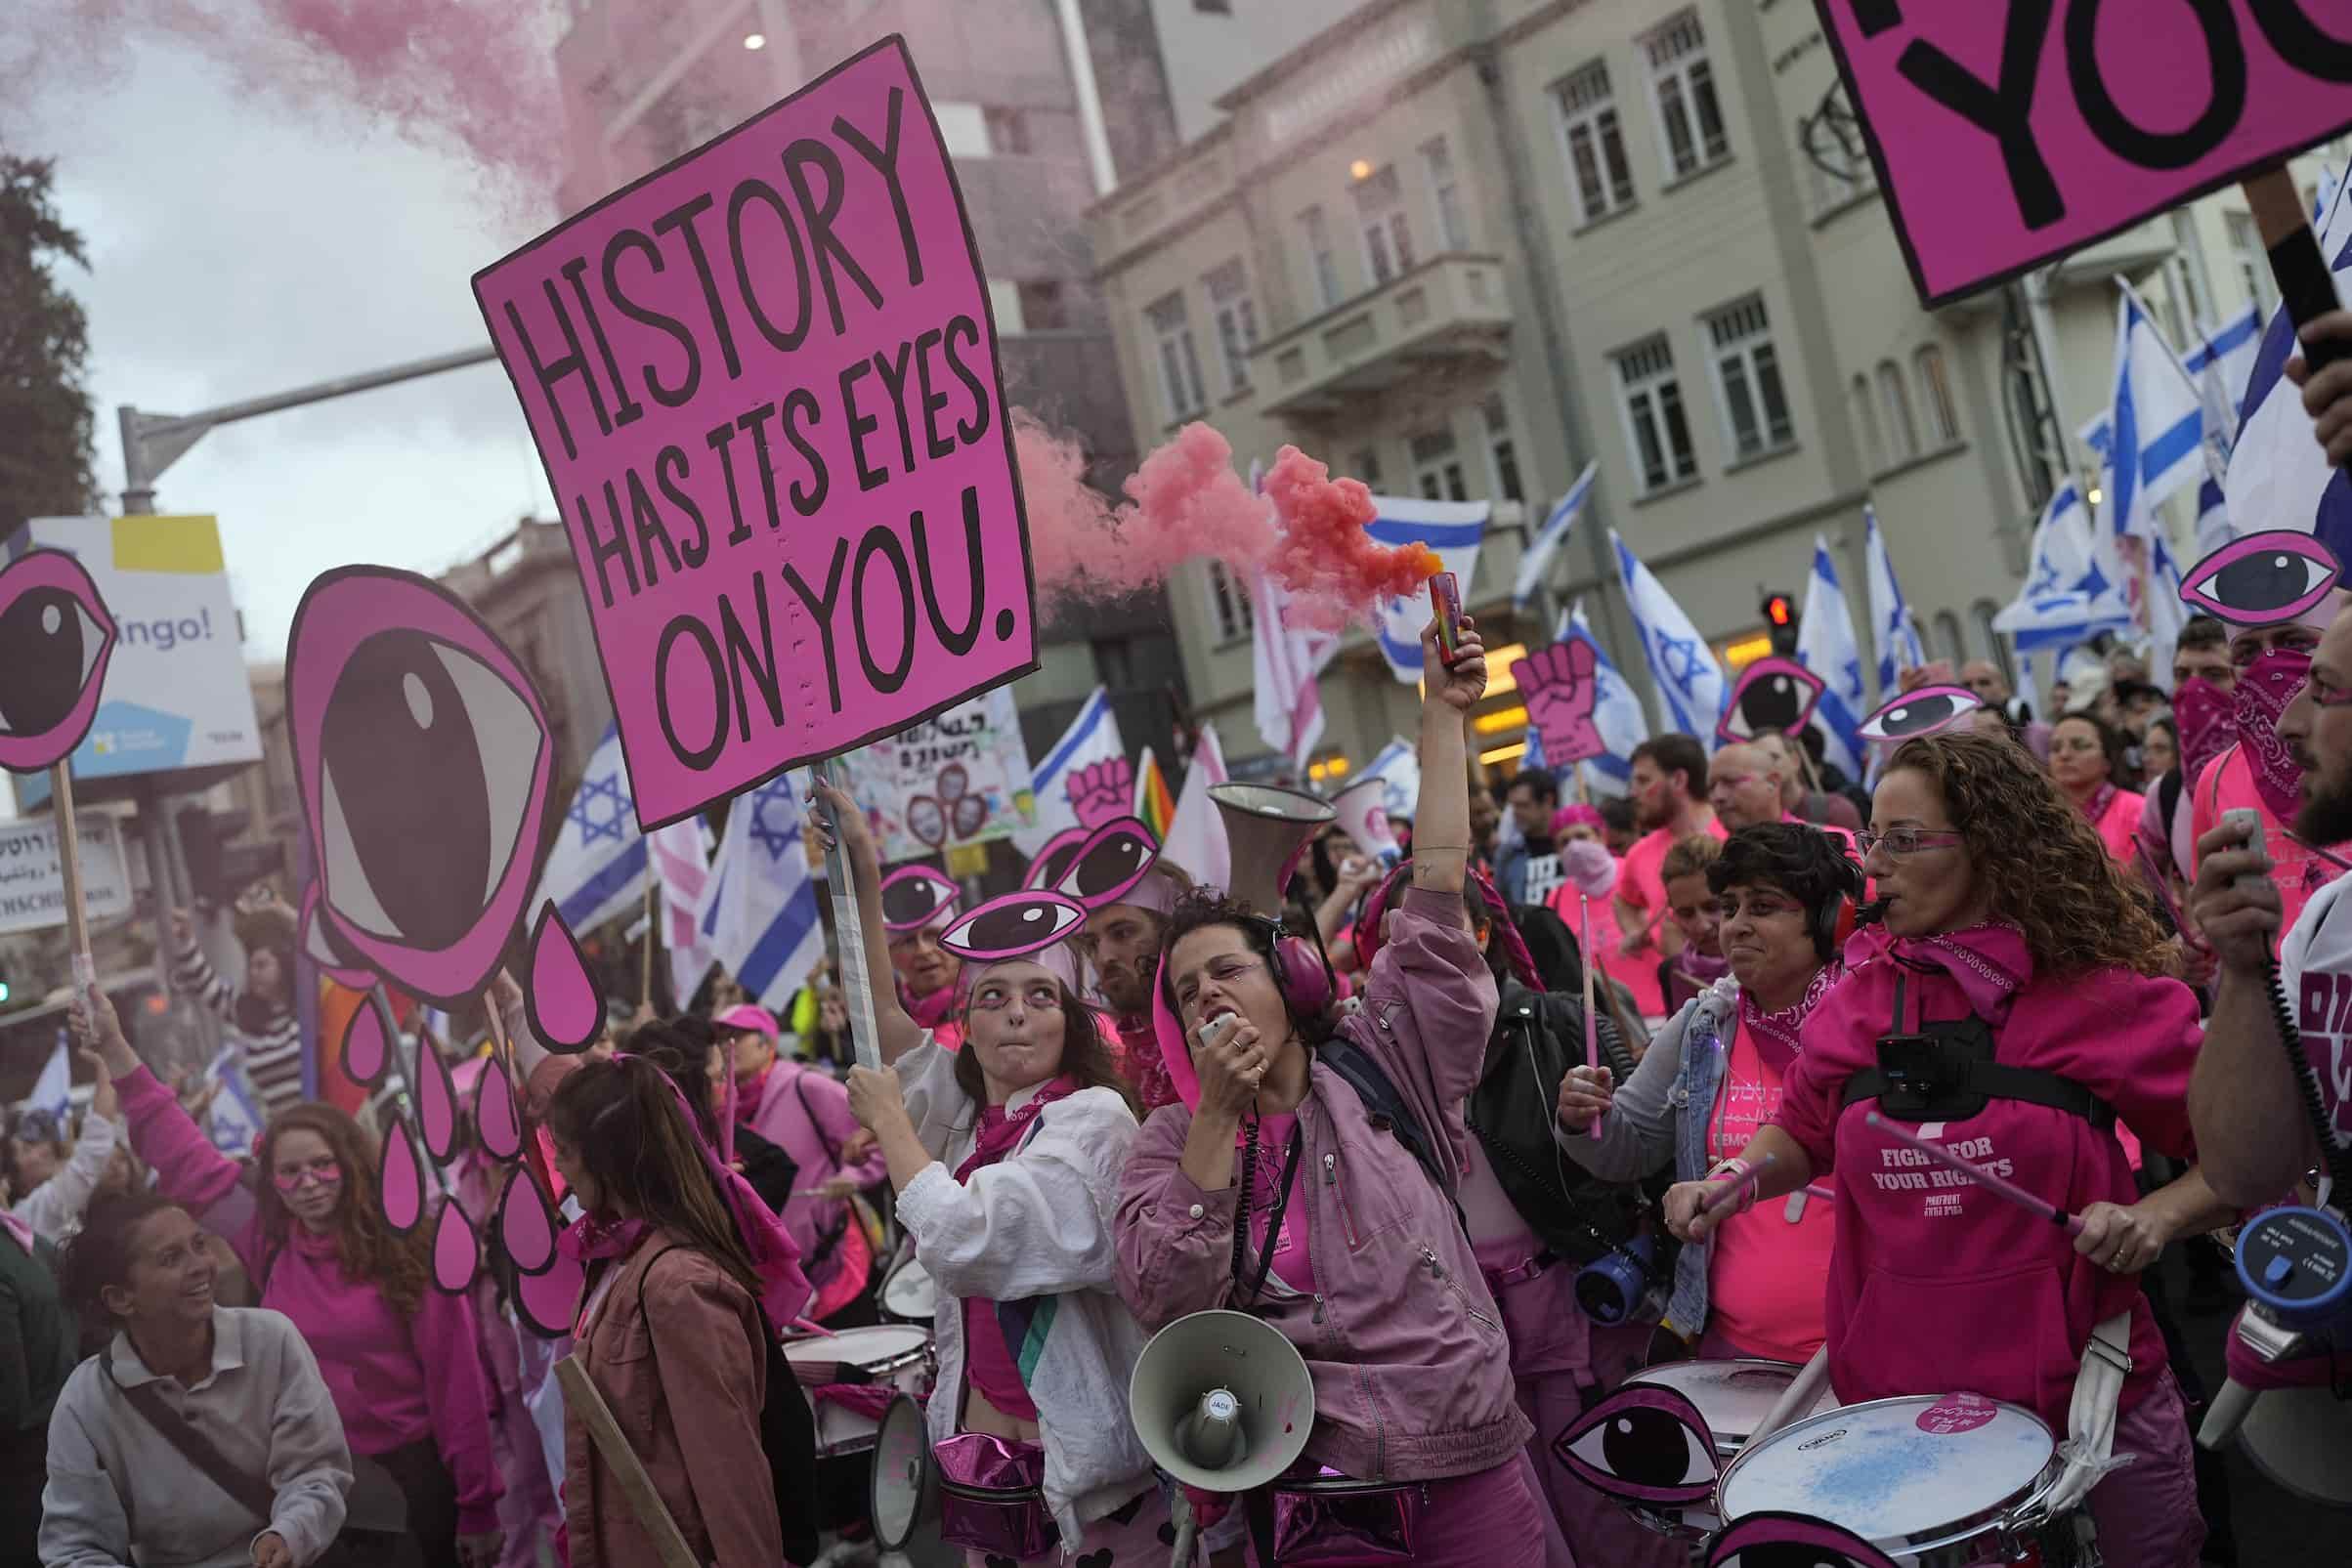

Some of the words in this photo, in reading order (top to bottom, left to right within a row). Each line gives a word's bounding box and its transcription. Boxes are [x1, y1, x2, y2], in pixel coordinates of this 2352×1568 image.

[503, 86, 924, 462] HISTORY
[577, 445, 709, 609] HAS
[706, 388, 830, 547] ITS
[838, 315, 990, 491] EYES
[116, 605, 212, 653] ingo!
[655, 570, 785, 772] ON
[782, 485, 1015, 714] YOU.
[1712, 1132, 1752, 1148] DEMO
[1881, 1147, 1940, 1167] FIGH
[1946, 1136, 1994, 1161] FOR
[1871, 1171, 1929, 1190] YOUR
[1930, 1158, 2014, 1188] RIGTS
